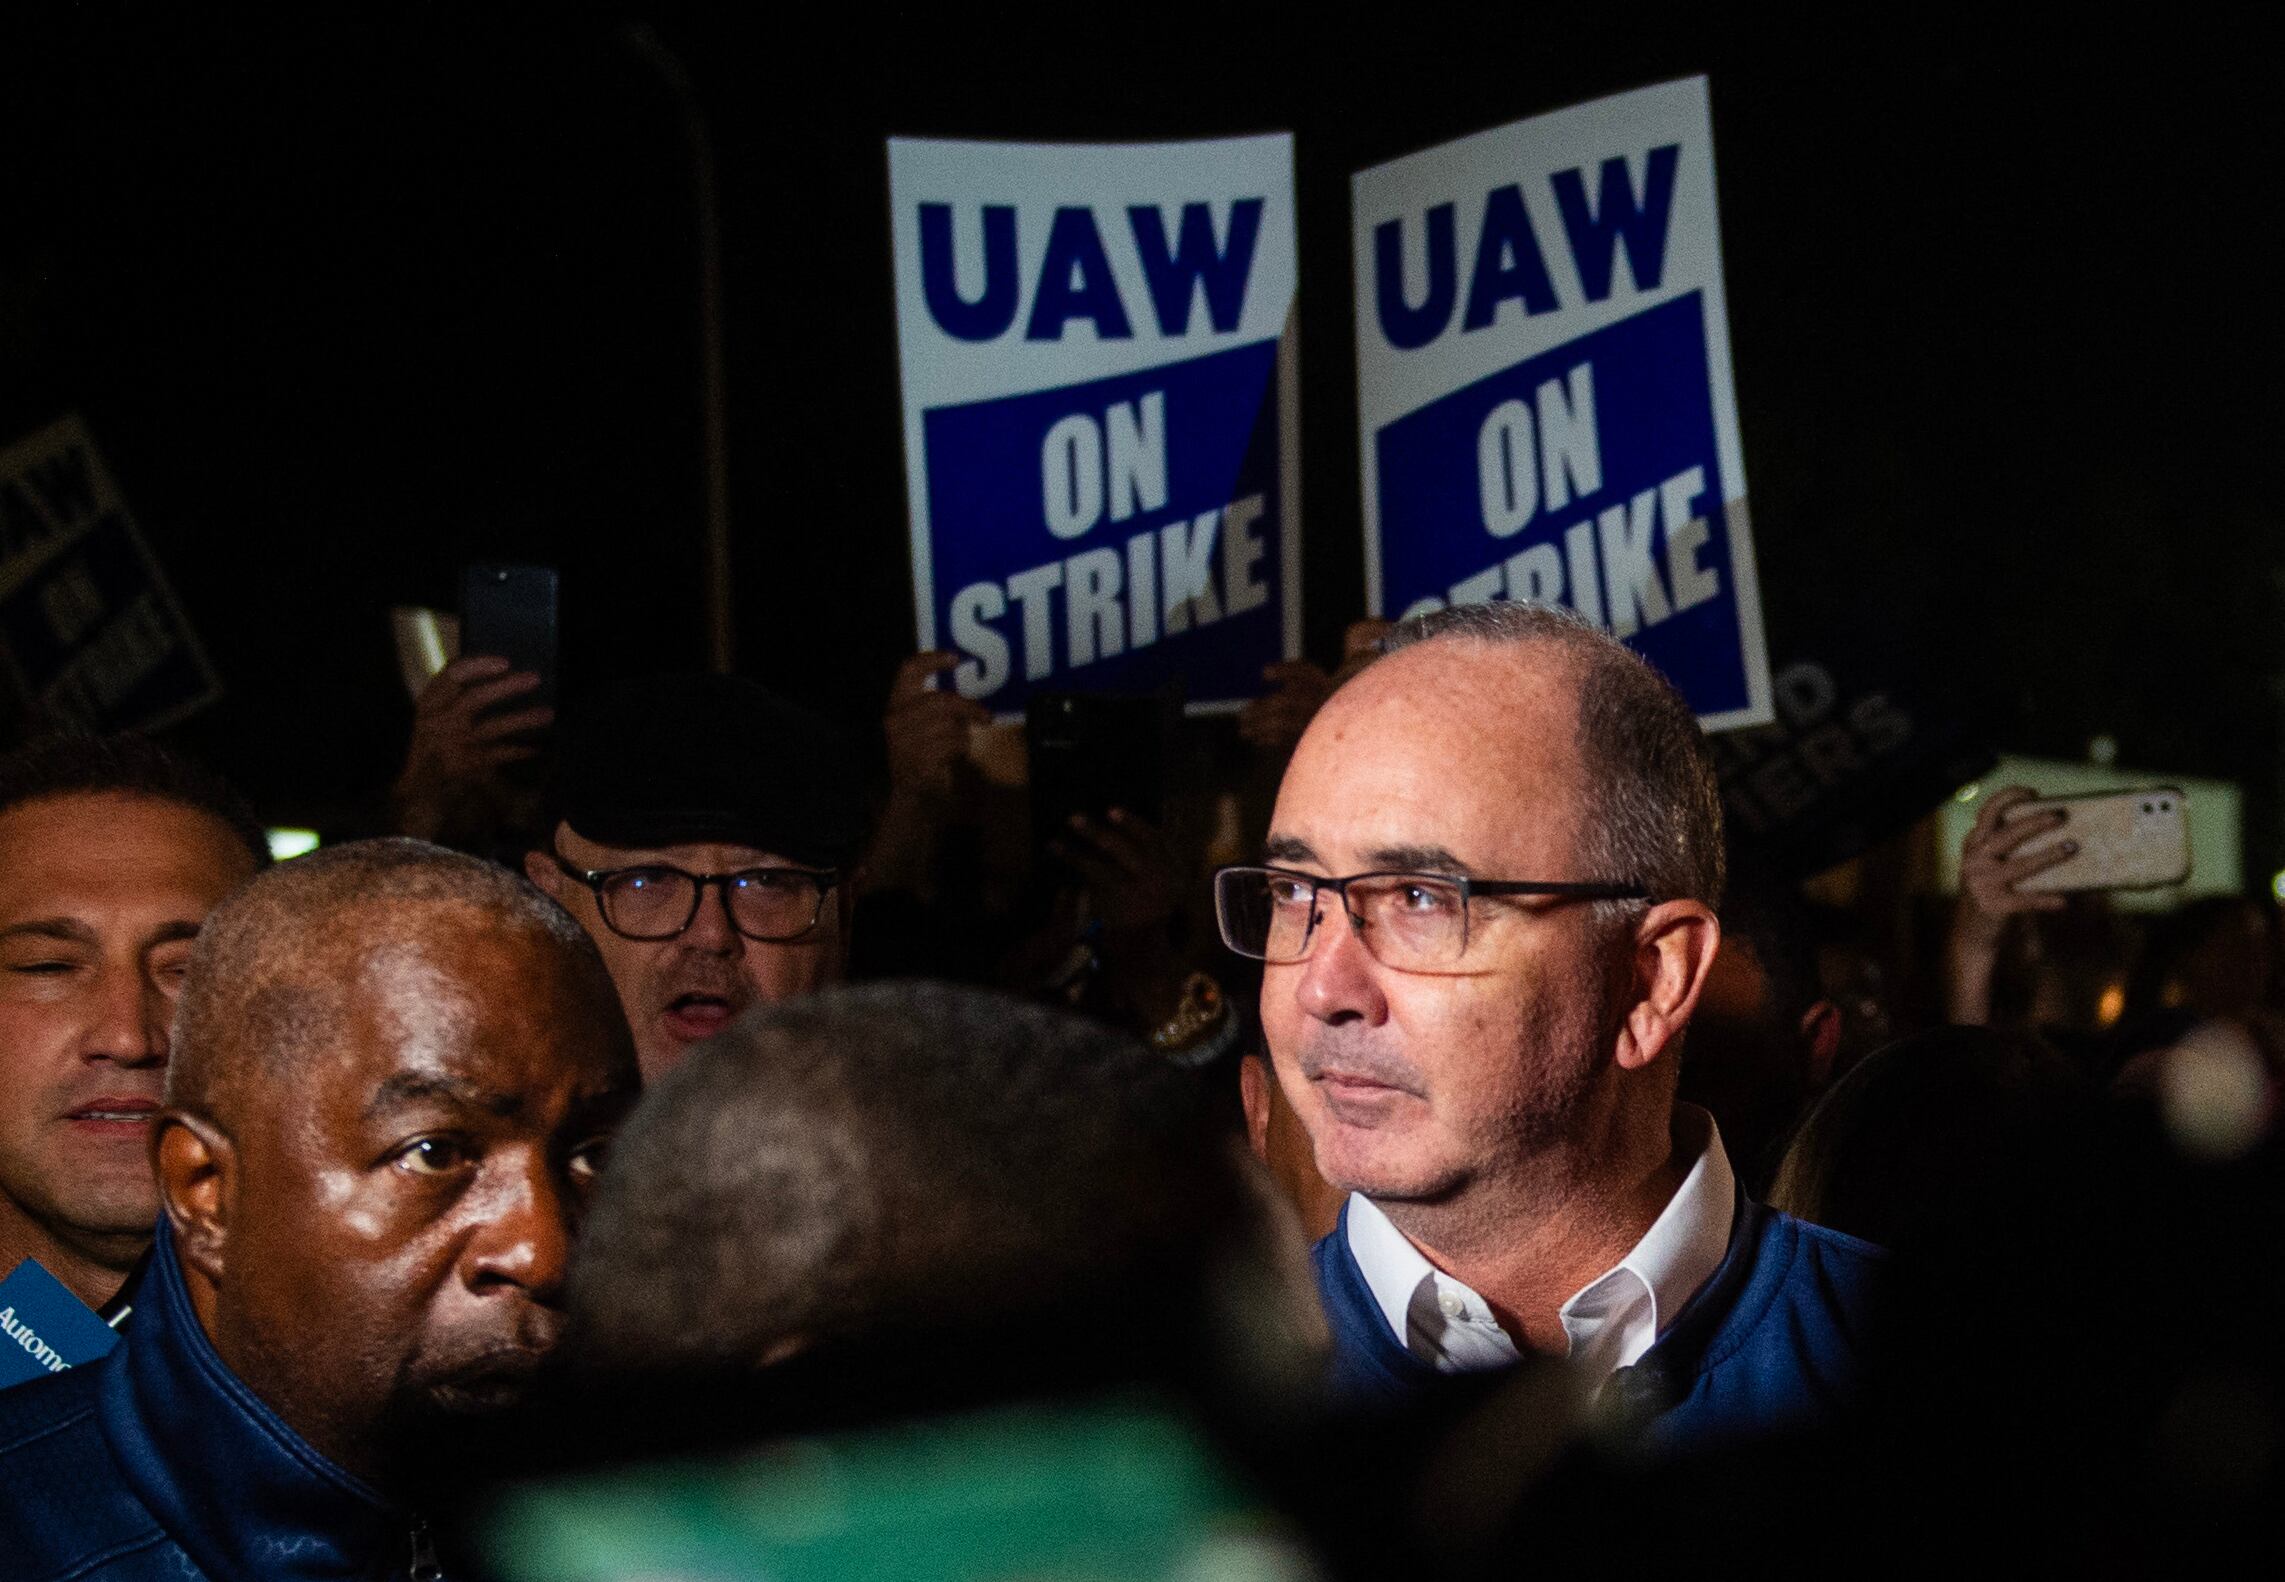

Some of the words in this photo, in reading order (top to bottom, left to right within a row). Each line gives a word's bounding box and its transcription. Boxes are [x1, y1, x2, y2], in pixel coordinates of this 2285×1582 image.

[918, 199, 1265, 341] UAW
[1375, 142, 1682, 350] UAW
[0, 447, 92, 552] AW
[1039, 388, 1169, 542] ON
[1475, 359, 1604, 541] ON
[948, 492, 1270, 701] STRIKE
